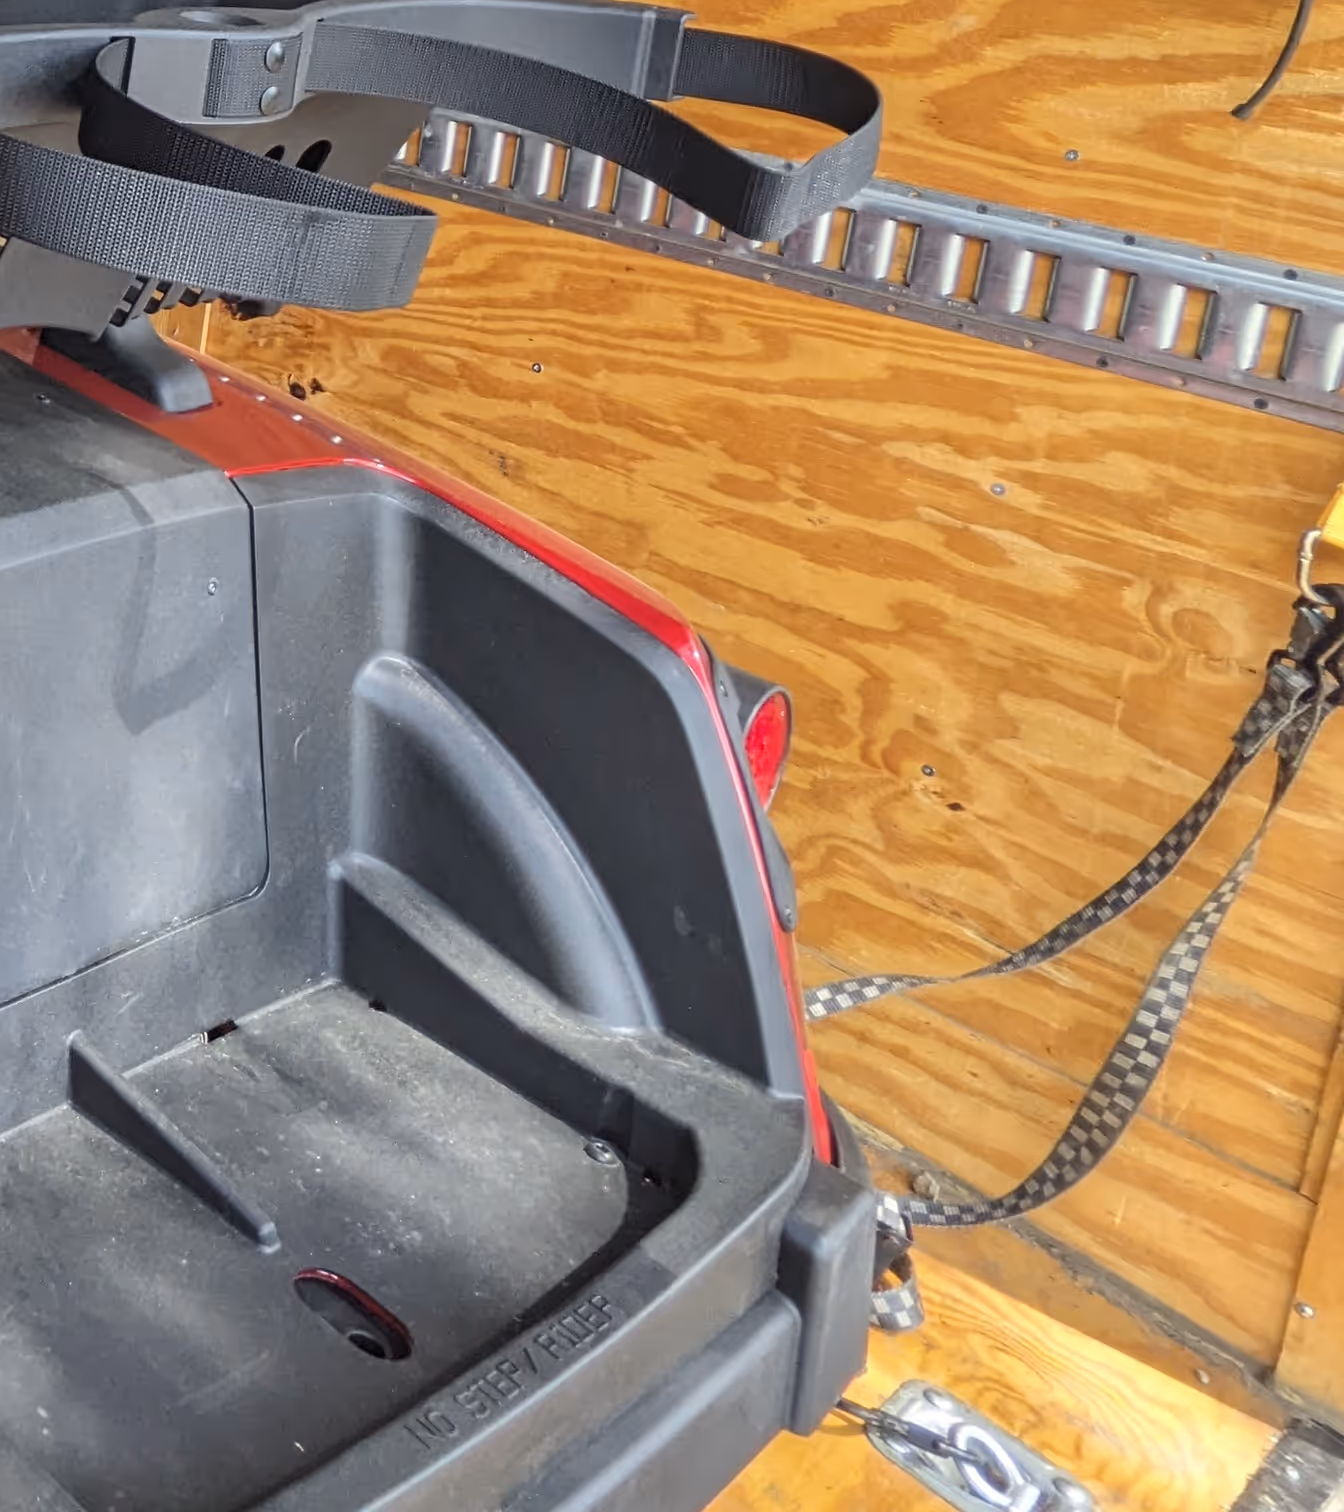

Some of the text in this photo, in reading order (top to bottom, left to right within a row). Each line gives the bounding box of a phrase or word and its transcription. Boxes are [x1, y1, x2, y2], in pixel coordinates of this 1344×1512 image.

[403, 1410, 457, 1450] NO
[453, 1359, 525, 1419] STEP
[534, 1294, 613, 1361] RIDER
